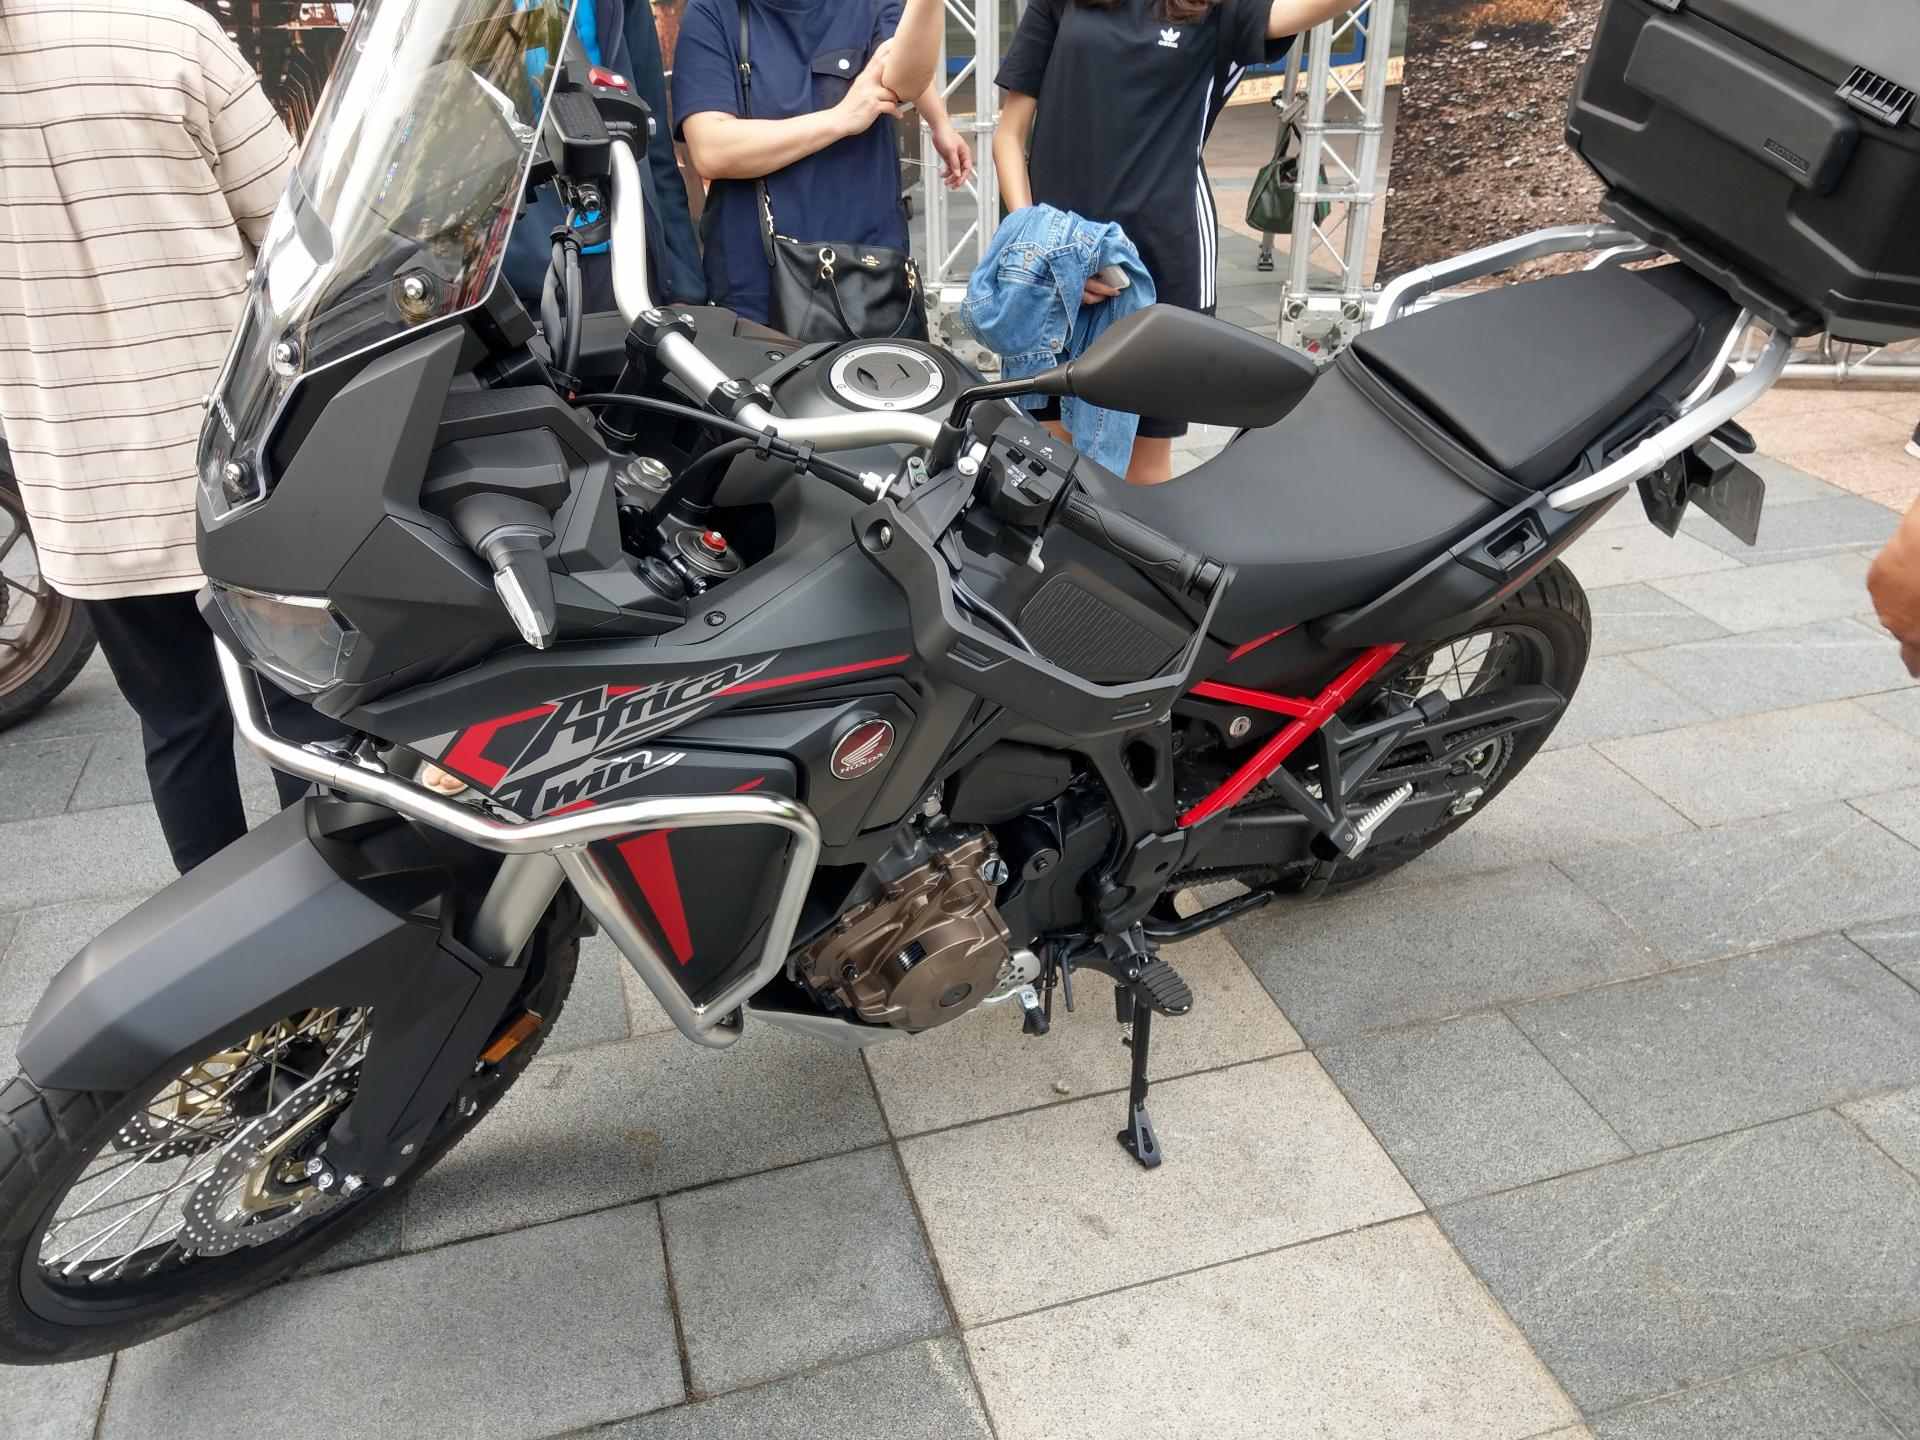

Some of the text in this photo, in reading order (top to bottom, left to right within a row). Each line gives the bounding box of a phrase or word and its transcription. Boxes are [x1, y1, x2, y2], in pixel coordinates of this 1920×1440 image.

[214, 390, 235, 442] ONDA
[492, 653, 782, 795] Africa
[840, 751, 883, 774] HONDA
